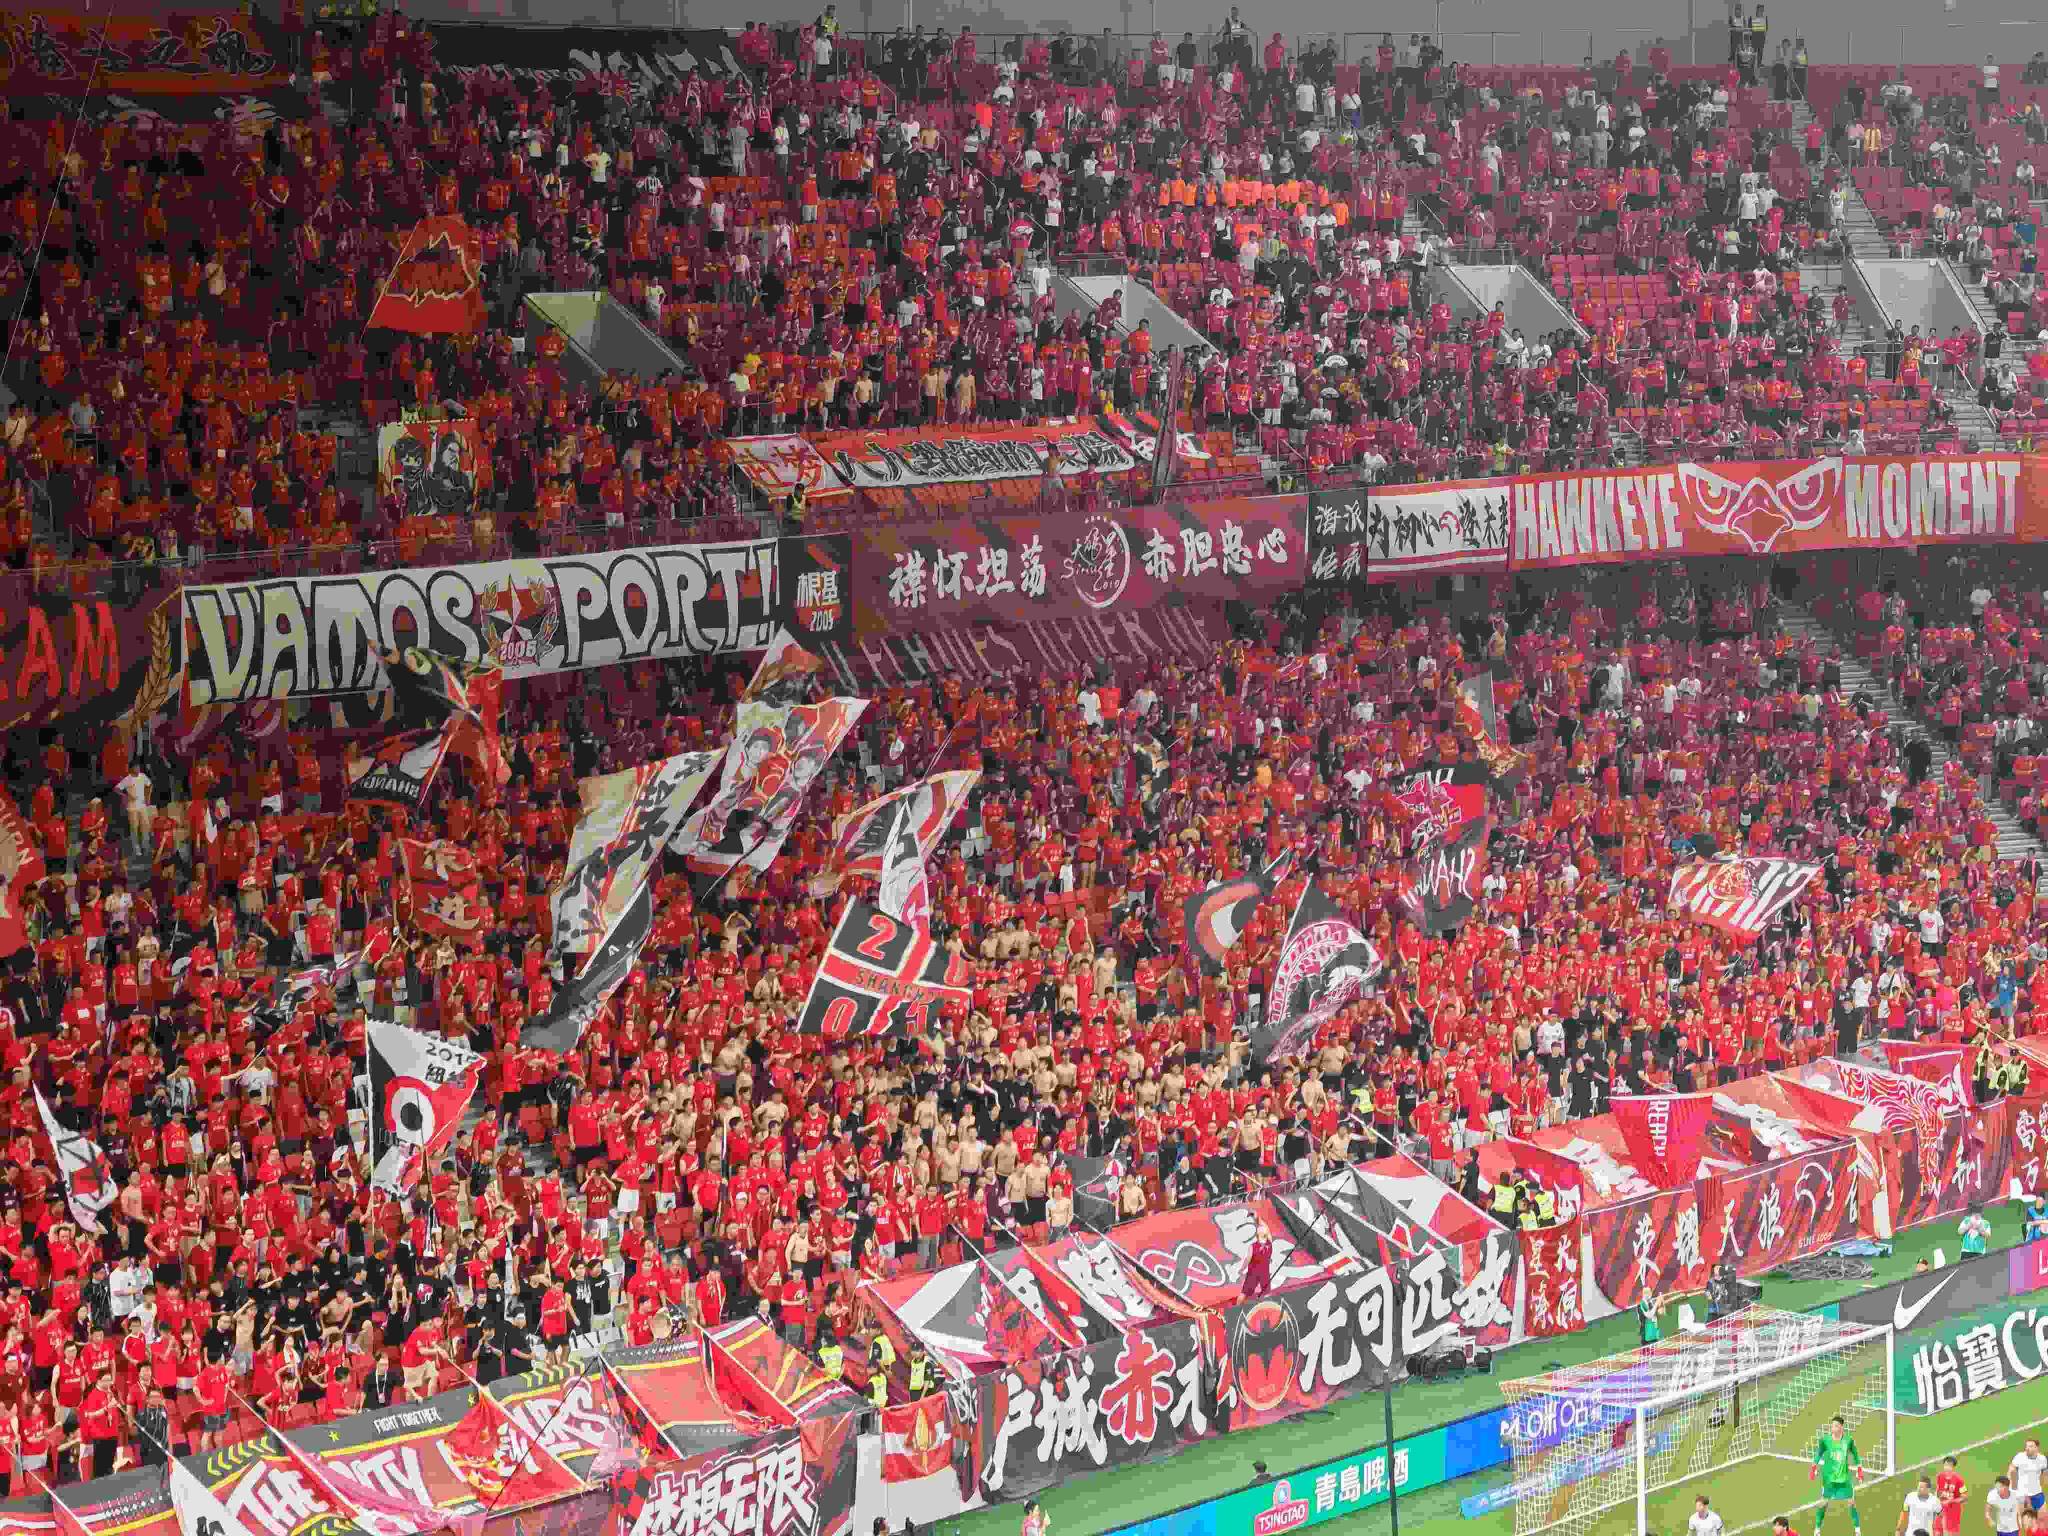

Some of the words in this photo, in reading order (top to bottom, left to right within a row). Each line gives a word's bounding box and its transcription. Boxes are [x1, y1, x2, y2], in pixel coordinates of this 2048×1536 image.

[1515, 472, 1683, 561] HAWKEYE
[1846, 461, 2020, 539] MOMENT
[1141, 518, 1290, 585] 赤胆忠心
[184, 569, 481, 702] VAMOS
[546, 542, 778, 670] PORT!
[796, 570, 841, 608] 根基
[856, 914, 898, 961] 2
[1912, 1322, 2008, 1415] 怡寶
[373, 1414, 399, 1434] FIGHT
[397, 1406, 443, 1428] TOGETHER
[1314, 1447, 1410, 1514] 青島啤酒
[1257, 1503, 1307, 1532] TSINGTAO
